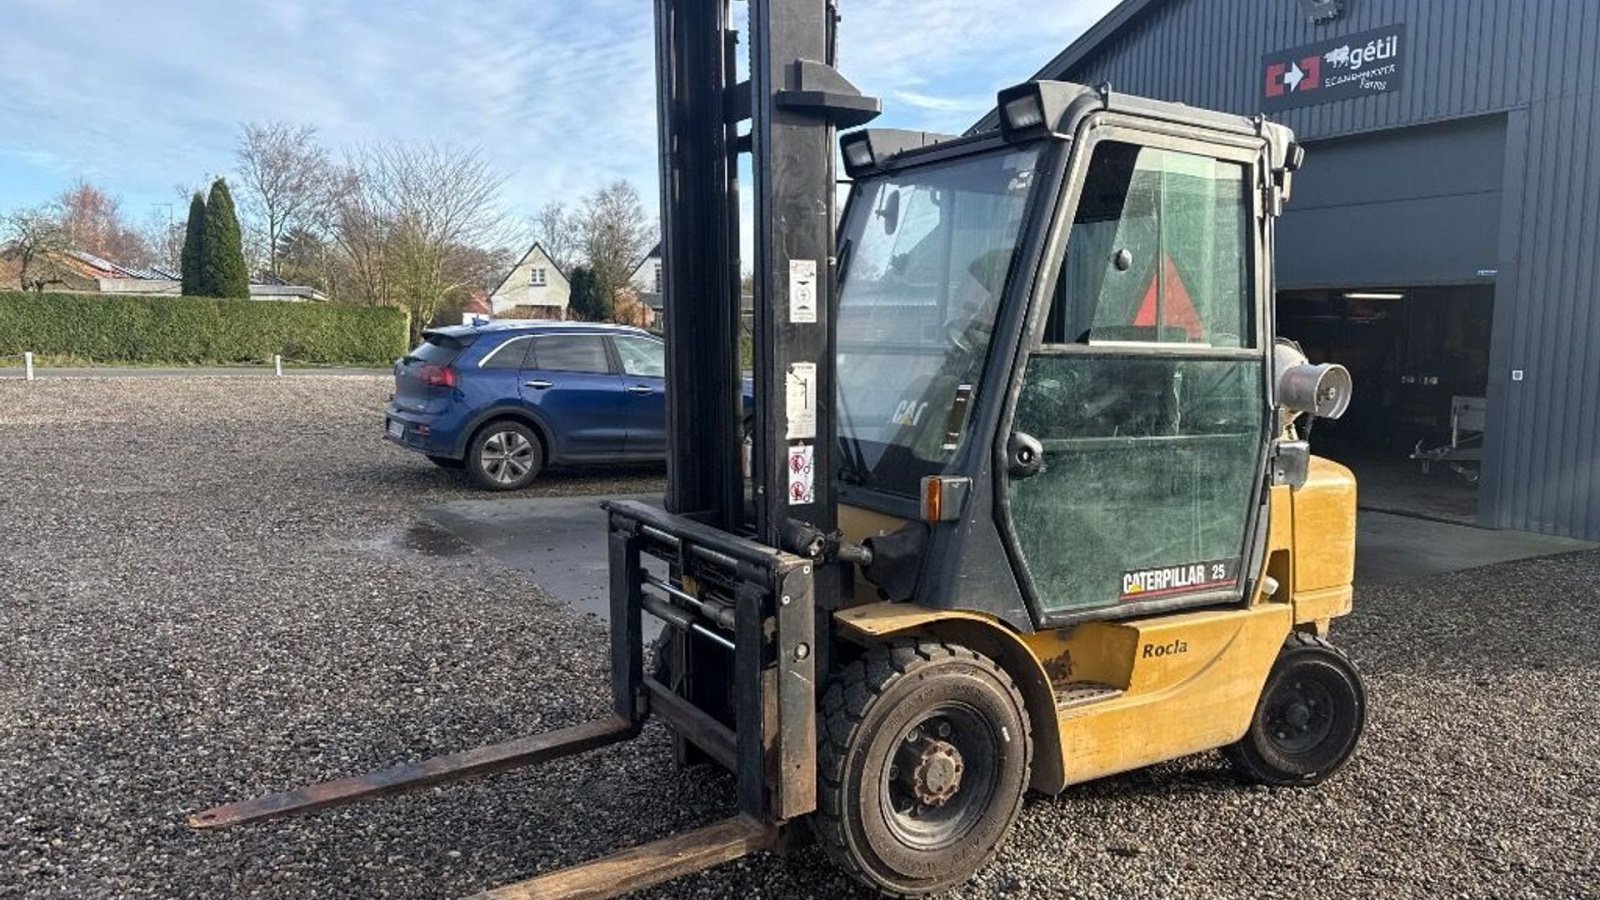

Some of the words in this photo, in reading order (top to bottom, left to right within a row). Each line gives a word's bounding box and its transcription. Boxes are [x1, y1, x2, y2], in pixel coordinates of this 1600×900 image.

[1349, 35, 1398, 70] gétil
[1123, 565, 1205, 594] CATERPILLAR
[1211, 564, 1225, 580] 25
[1142, 639, 1188, 659] Rocla
